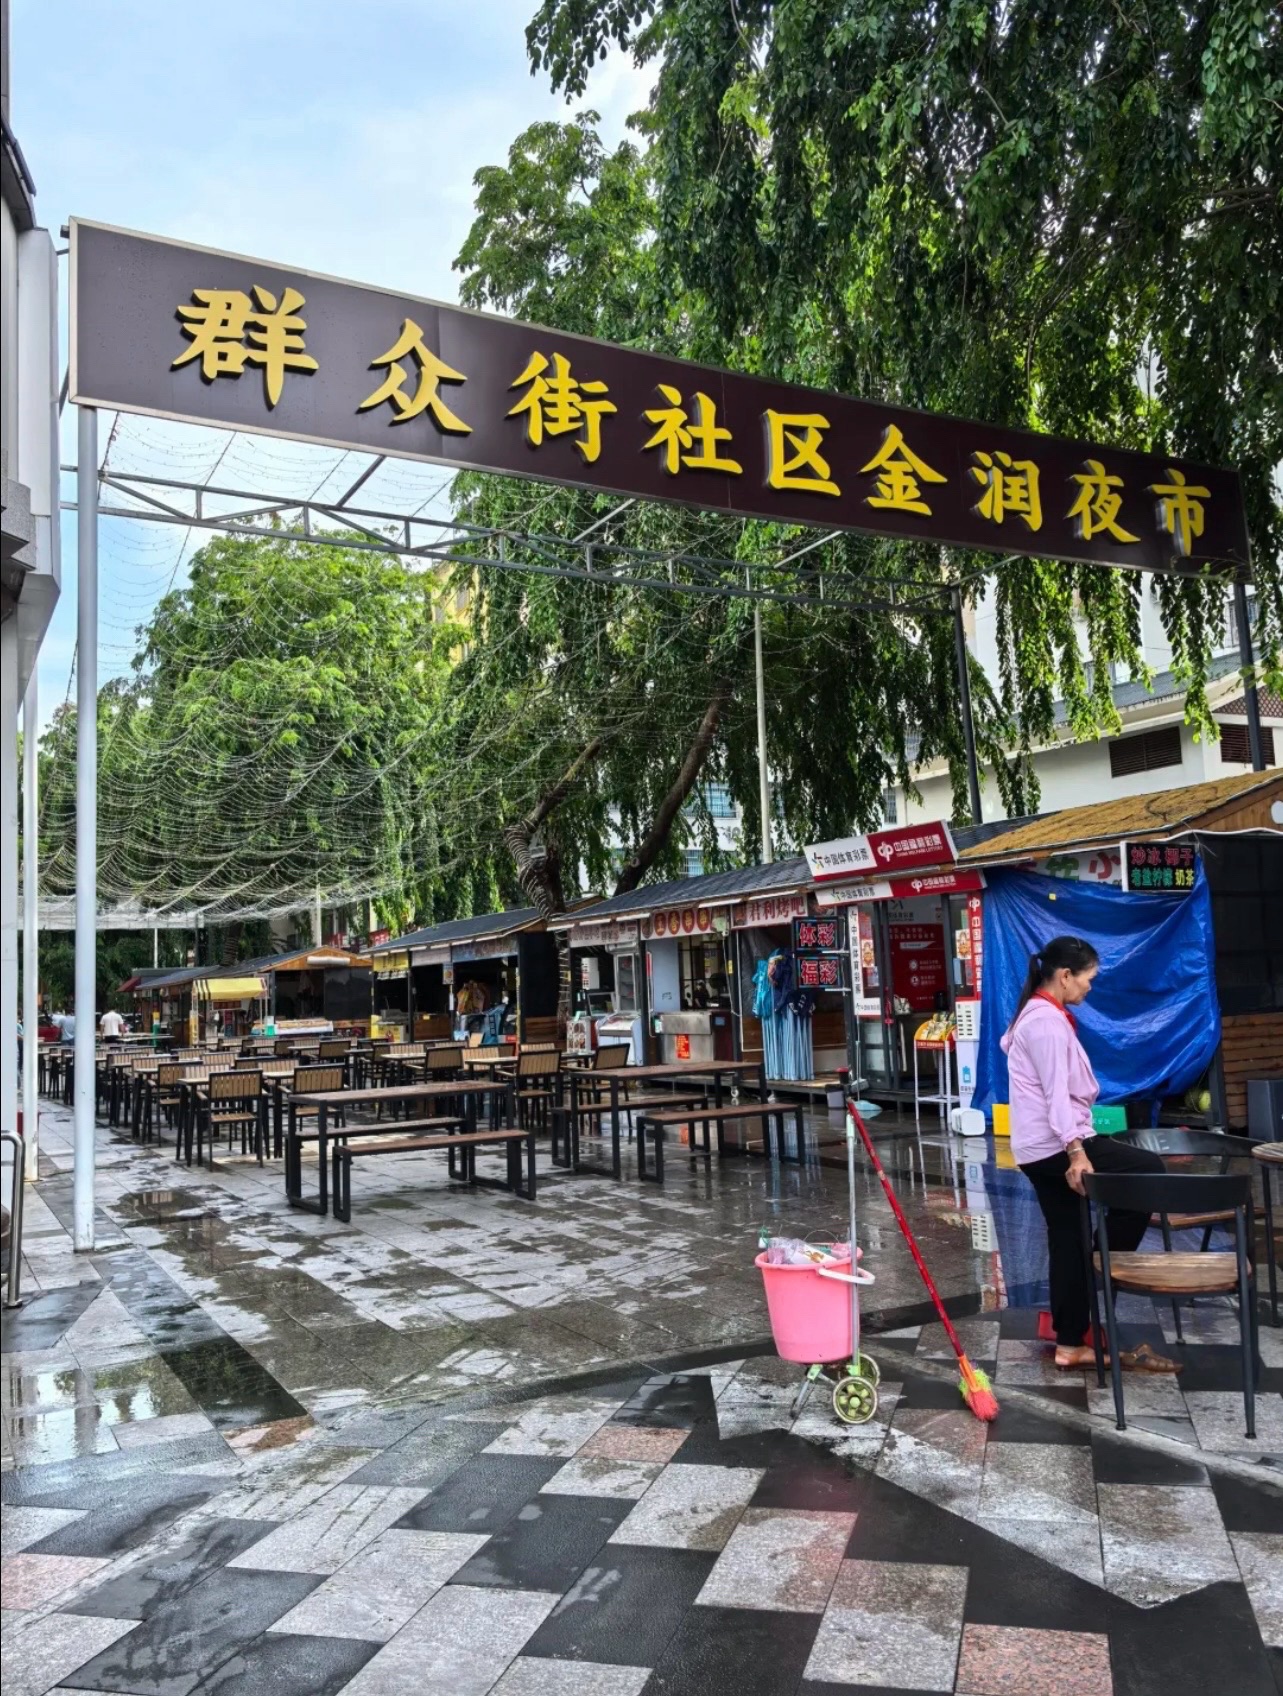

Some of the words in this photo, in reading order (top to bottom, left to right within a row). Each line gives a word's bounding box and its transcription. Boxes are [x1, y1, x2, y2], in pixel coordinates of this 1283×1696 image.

[172, 284, 1212, 557] 群众街社区金润夜市
[824, 848, 870, 865] 中国体育彩票
[799, 922, 835, 946] 体彩
[801, 959, 838, 985] 福彩
